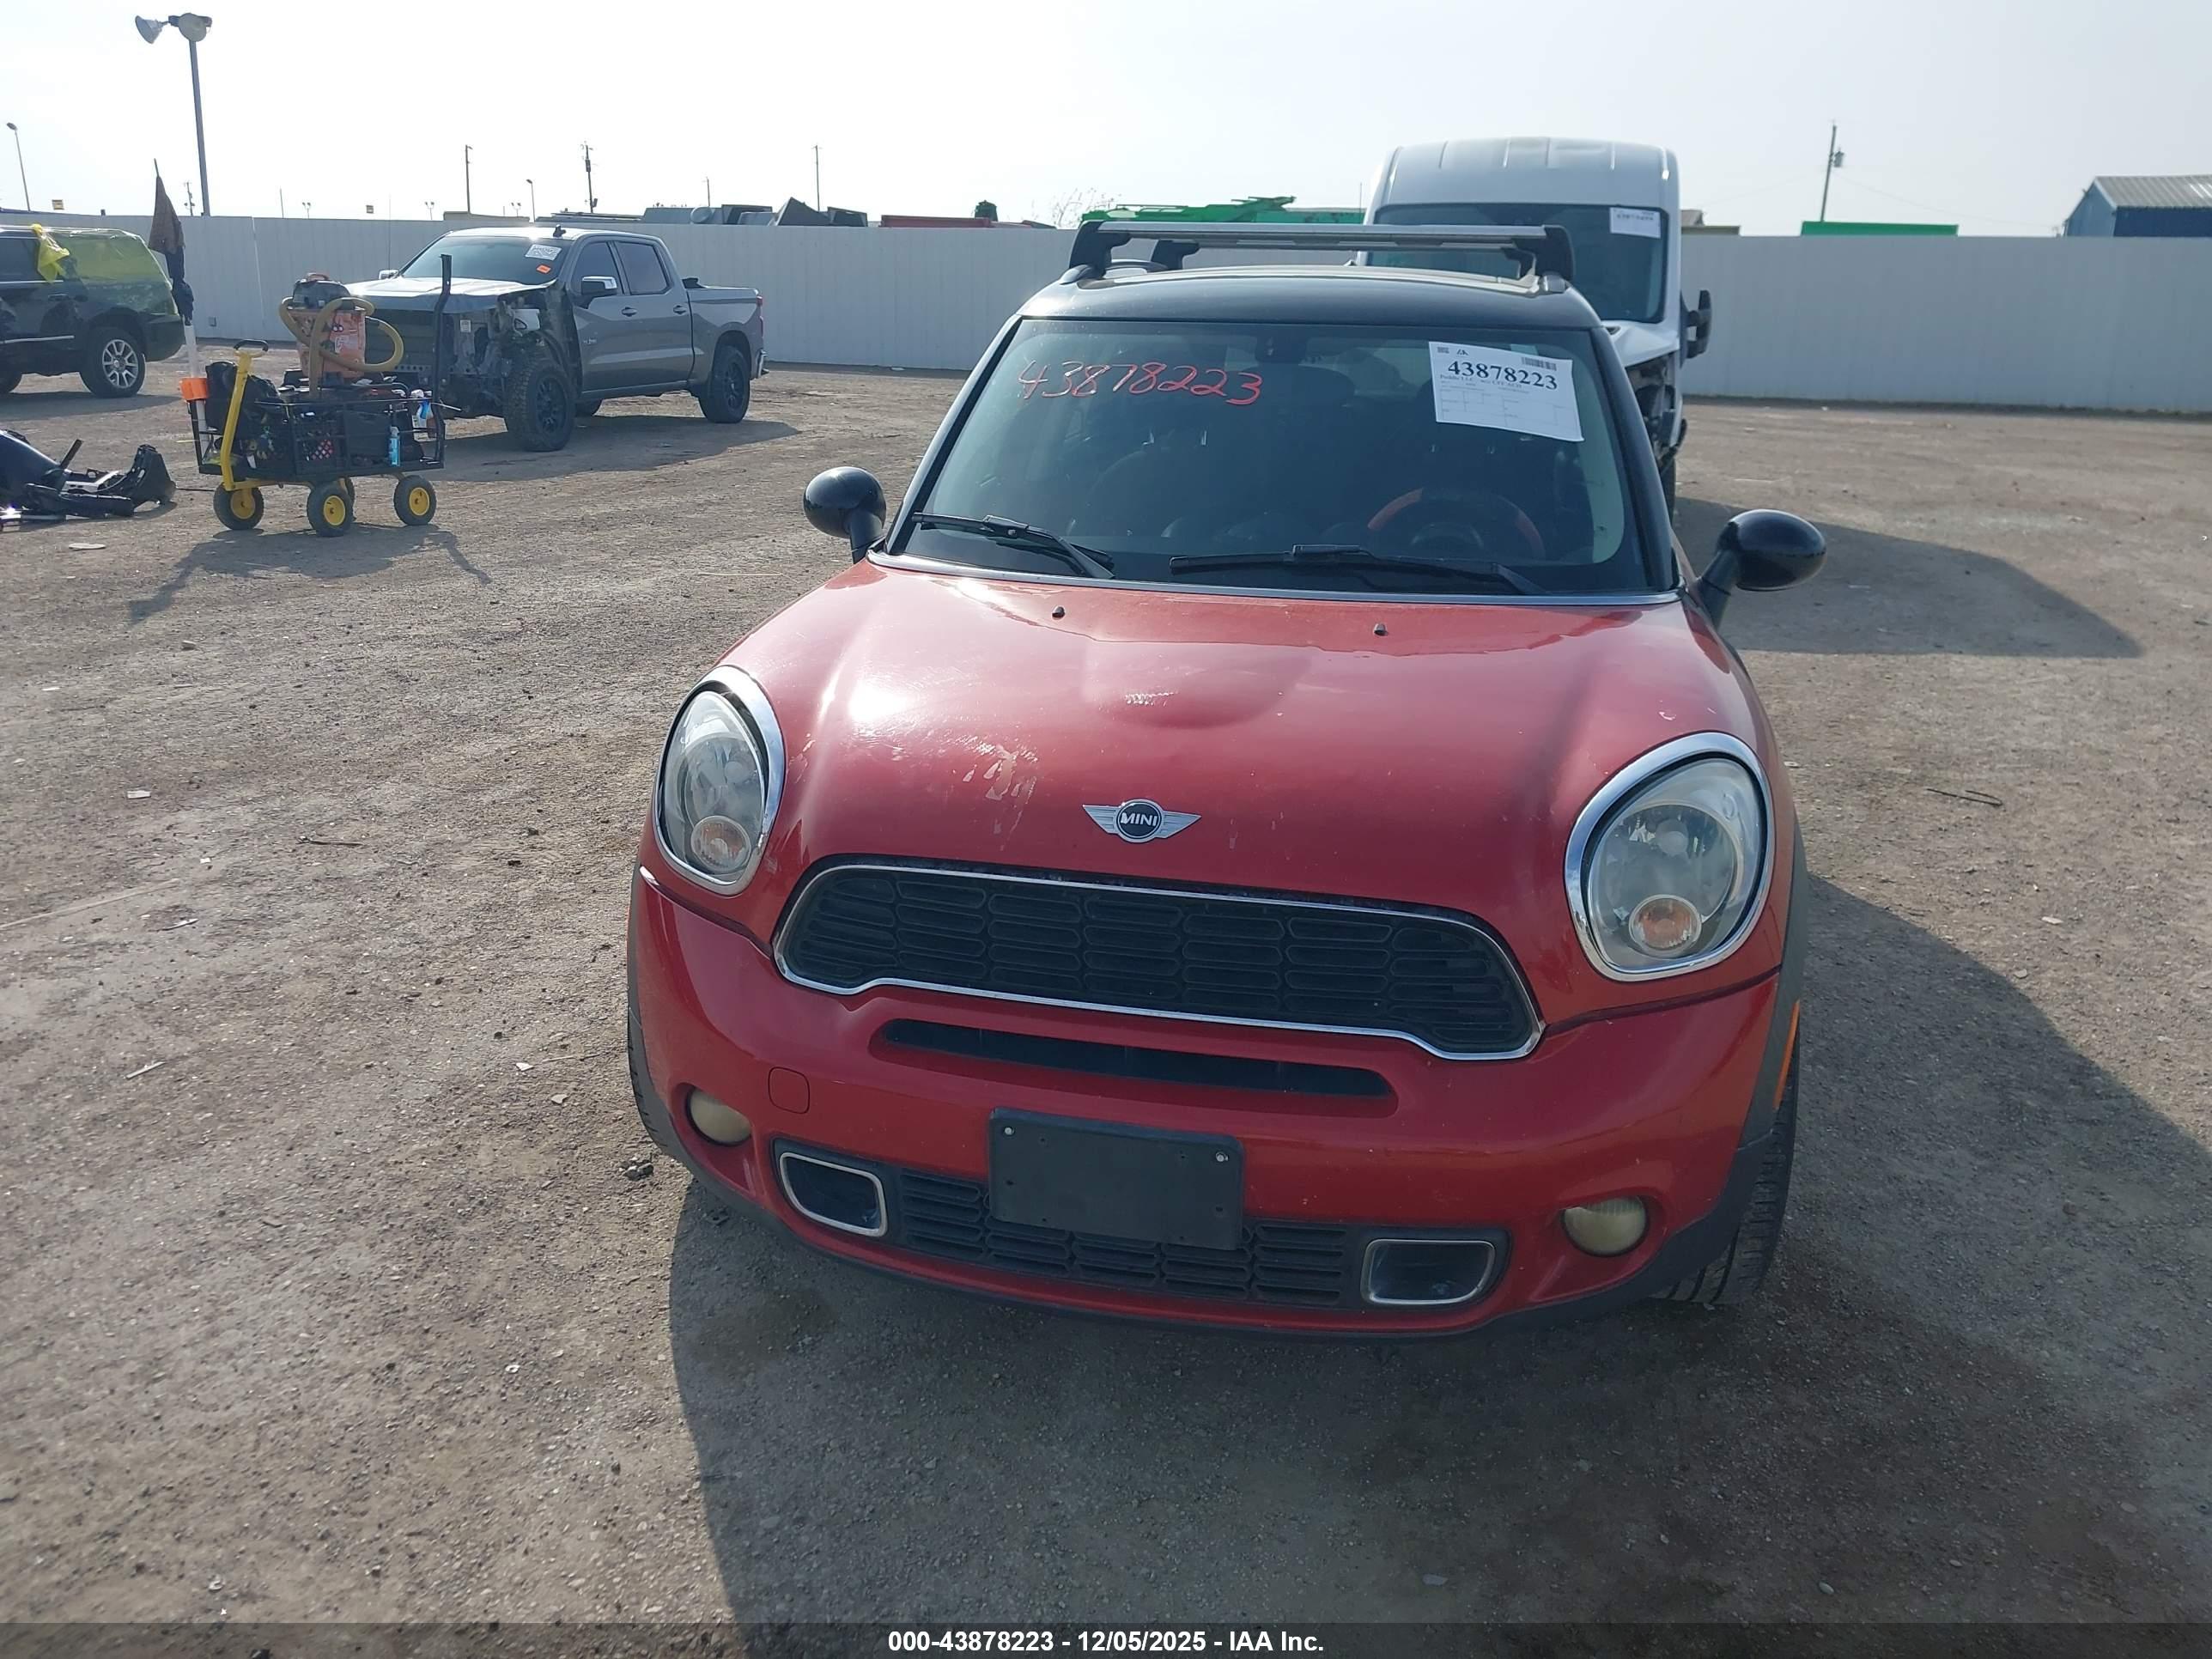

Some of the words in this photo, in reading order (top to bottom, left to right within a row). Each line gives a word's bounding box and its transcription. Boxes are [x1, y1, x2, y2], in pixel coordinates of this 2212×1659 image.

[1018, 360, 1262, 405] 43878223
[1448, 361, 1558, 390] 43878223
[1120, 812, 1158, 826] MINI
